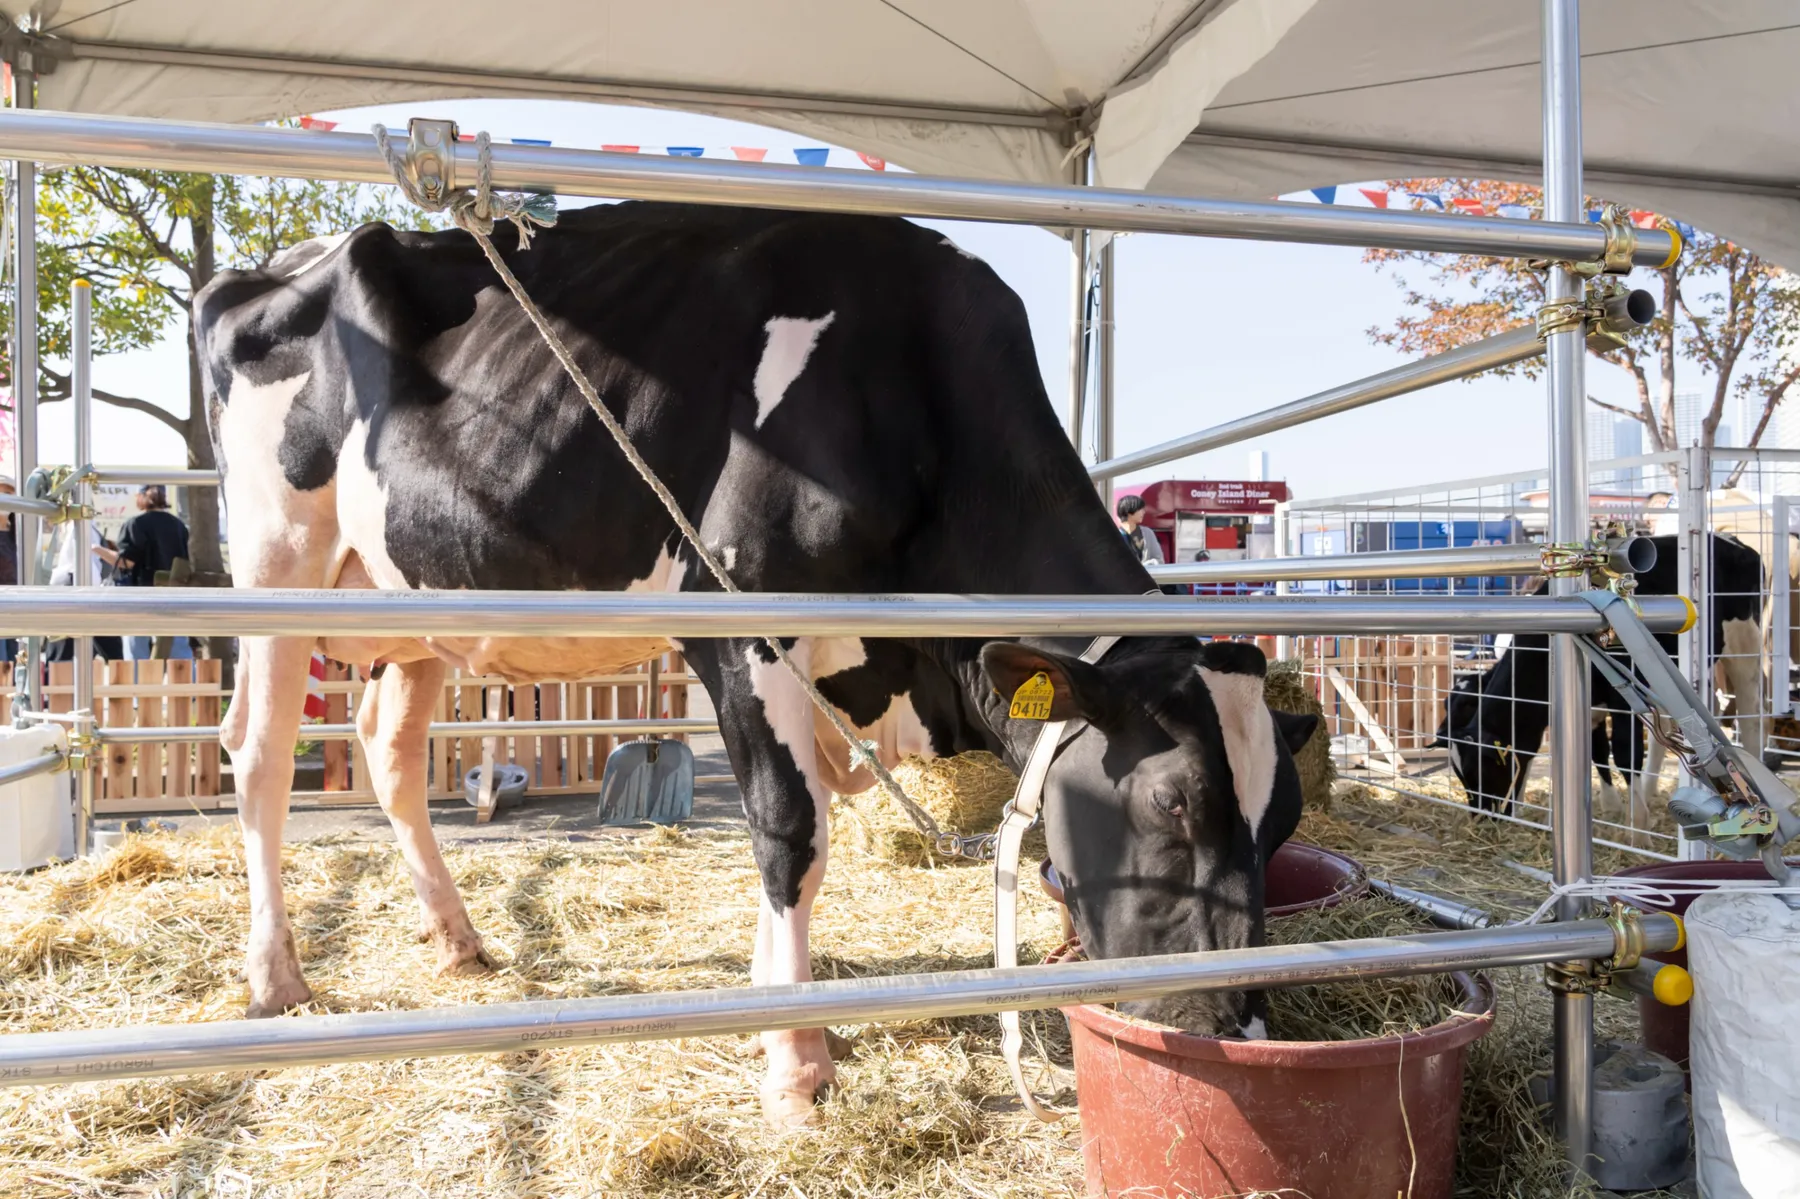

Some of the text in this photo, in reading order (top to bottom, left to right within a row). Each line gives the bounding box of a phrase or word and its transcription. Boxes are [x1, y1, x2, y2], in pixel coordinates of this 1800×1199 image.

[1190, 489, 1270, 499] Coney Island Diner
